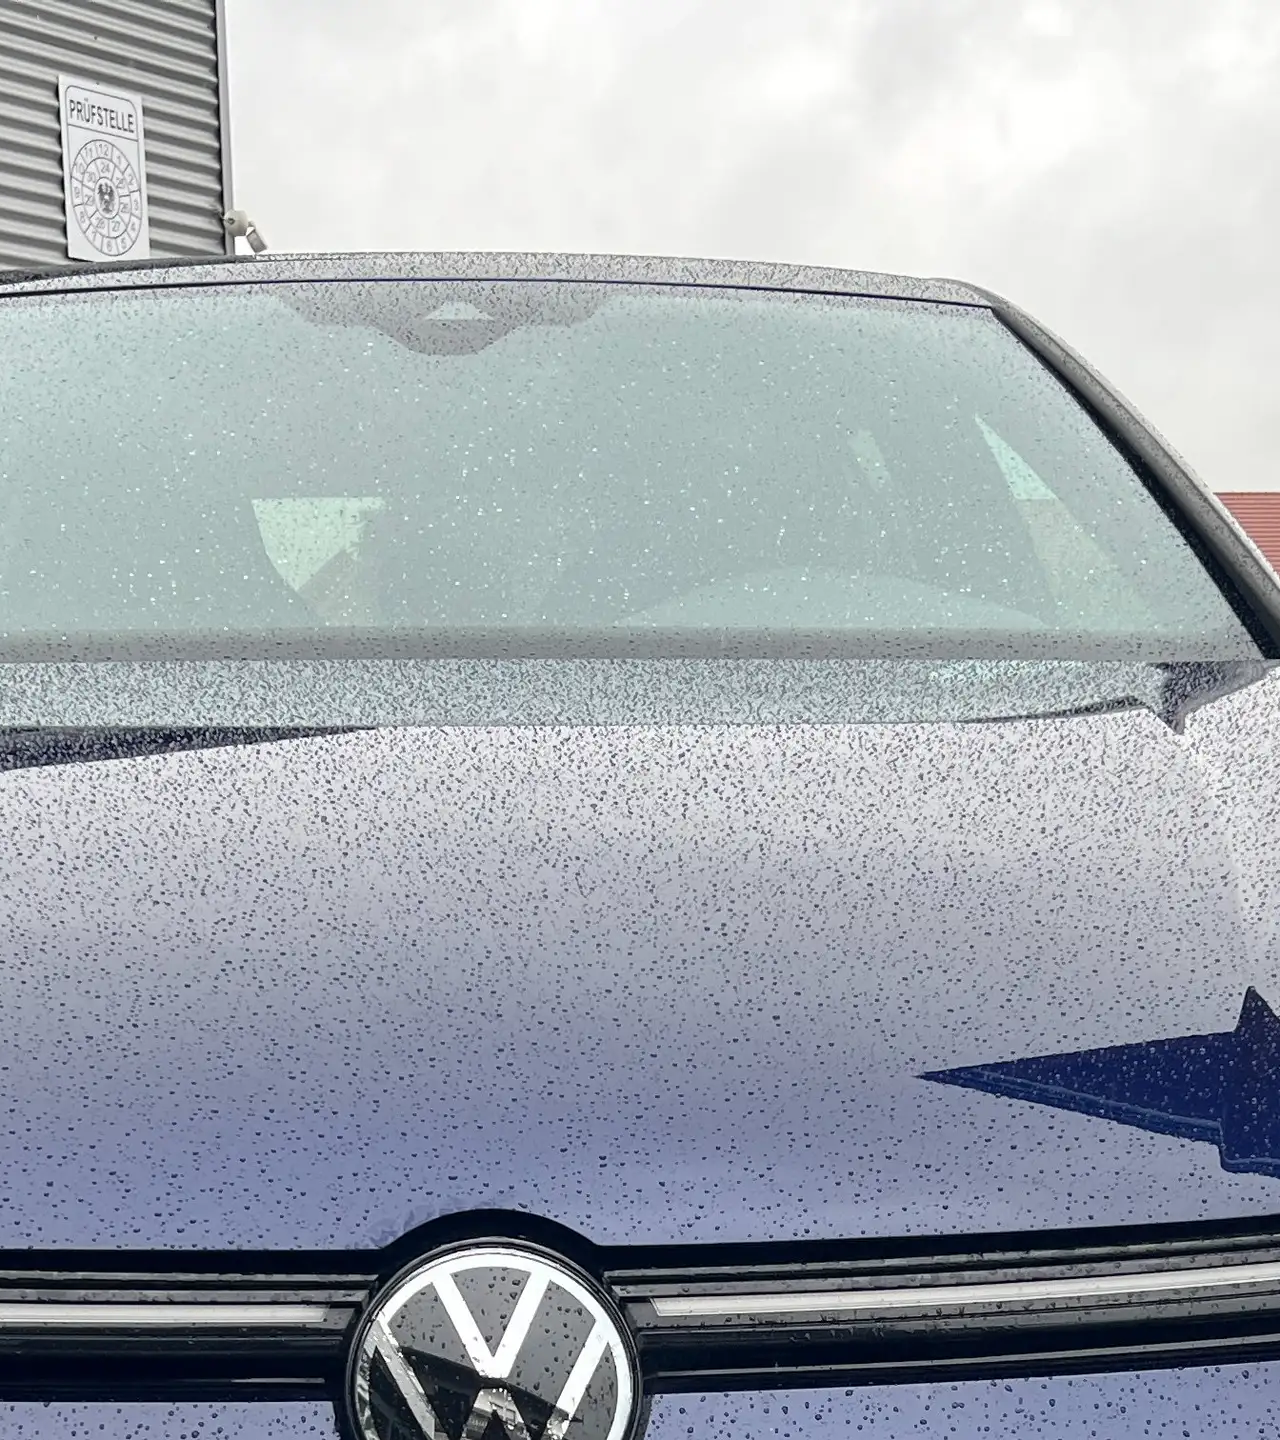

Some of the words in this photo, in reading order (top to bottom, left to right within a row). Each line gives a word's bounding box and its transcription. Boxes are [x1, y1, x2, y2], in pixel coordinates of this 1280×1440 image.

[70, 97, 135, 133] PRÜFSTELLE
[84, 146, 93, 159] 11
[98, 143, 109, 157] 12
[128, 174, 135, 186] 2
